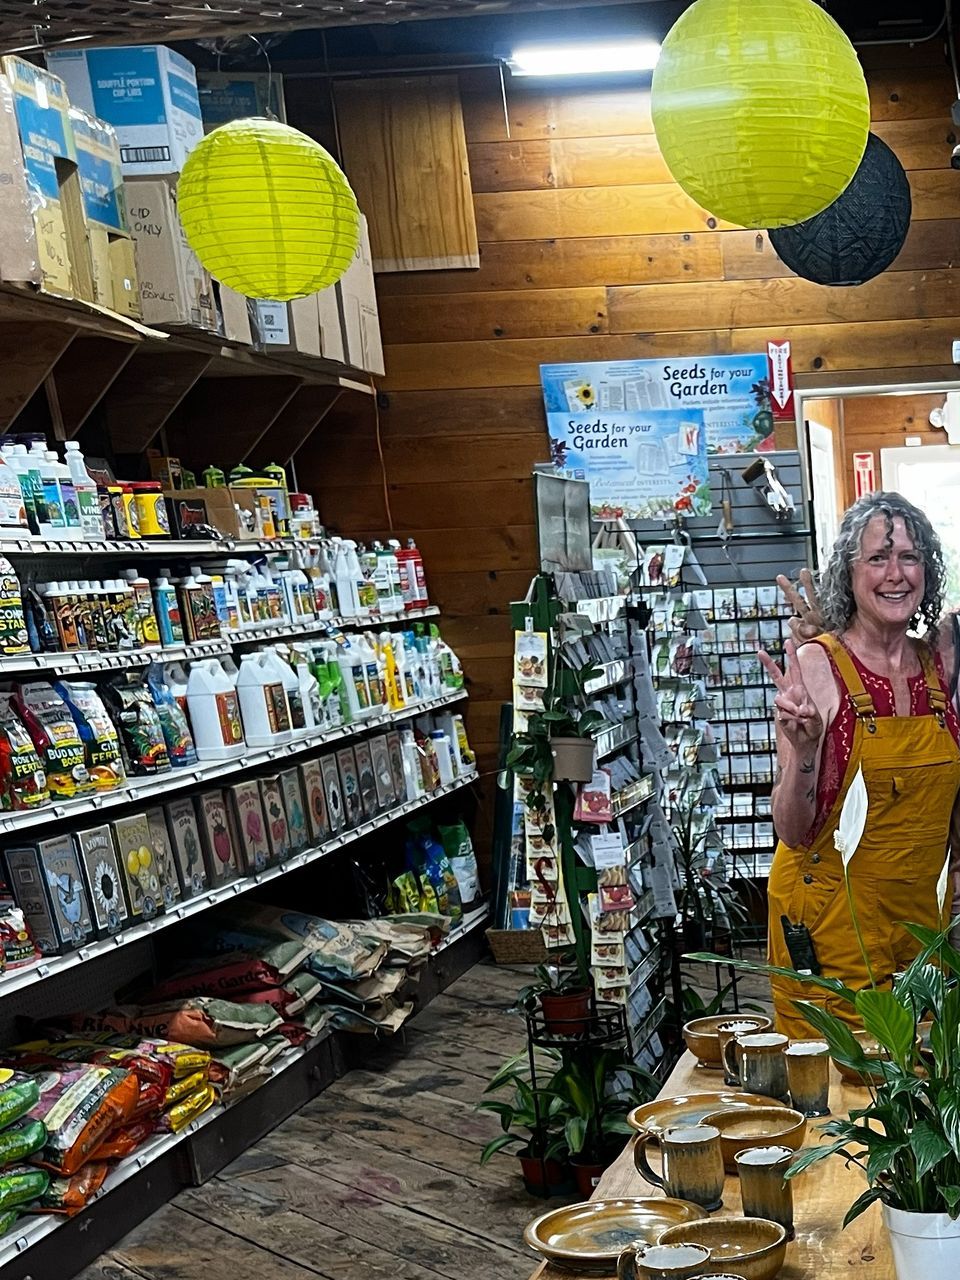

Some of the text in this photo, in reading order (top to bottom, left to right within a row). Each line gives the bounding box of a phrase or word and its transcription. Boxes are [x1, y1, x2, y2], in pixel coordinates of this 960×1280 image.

[134, 222, 162, 237] ONLY
[143, 290, 174, 301] BOWLS
[663, 363, 753, 381] Seeds for your
[670, 380, 728, 399] Garden
[568, 420, 652, 435] Seeds for your
[573, 435, 628, 451] Garden
[81, 506, 101, 514] VINE
[12, 755, 30, 765] ROSE
[49, 748, 66, 760] BUD
